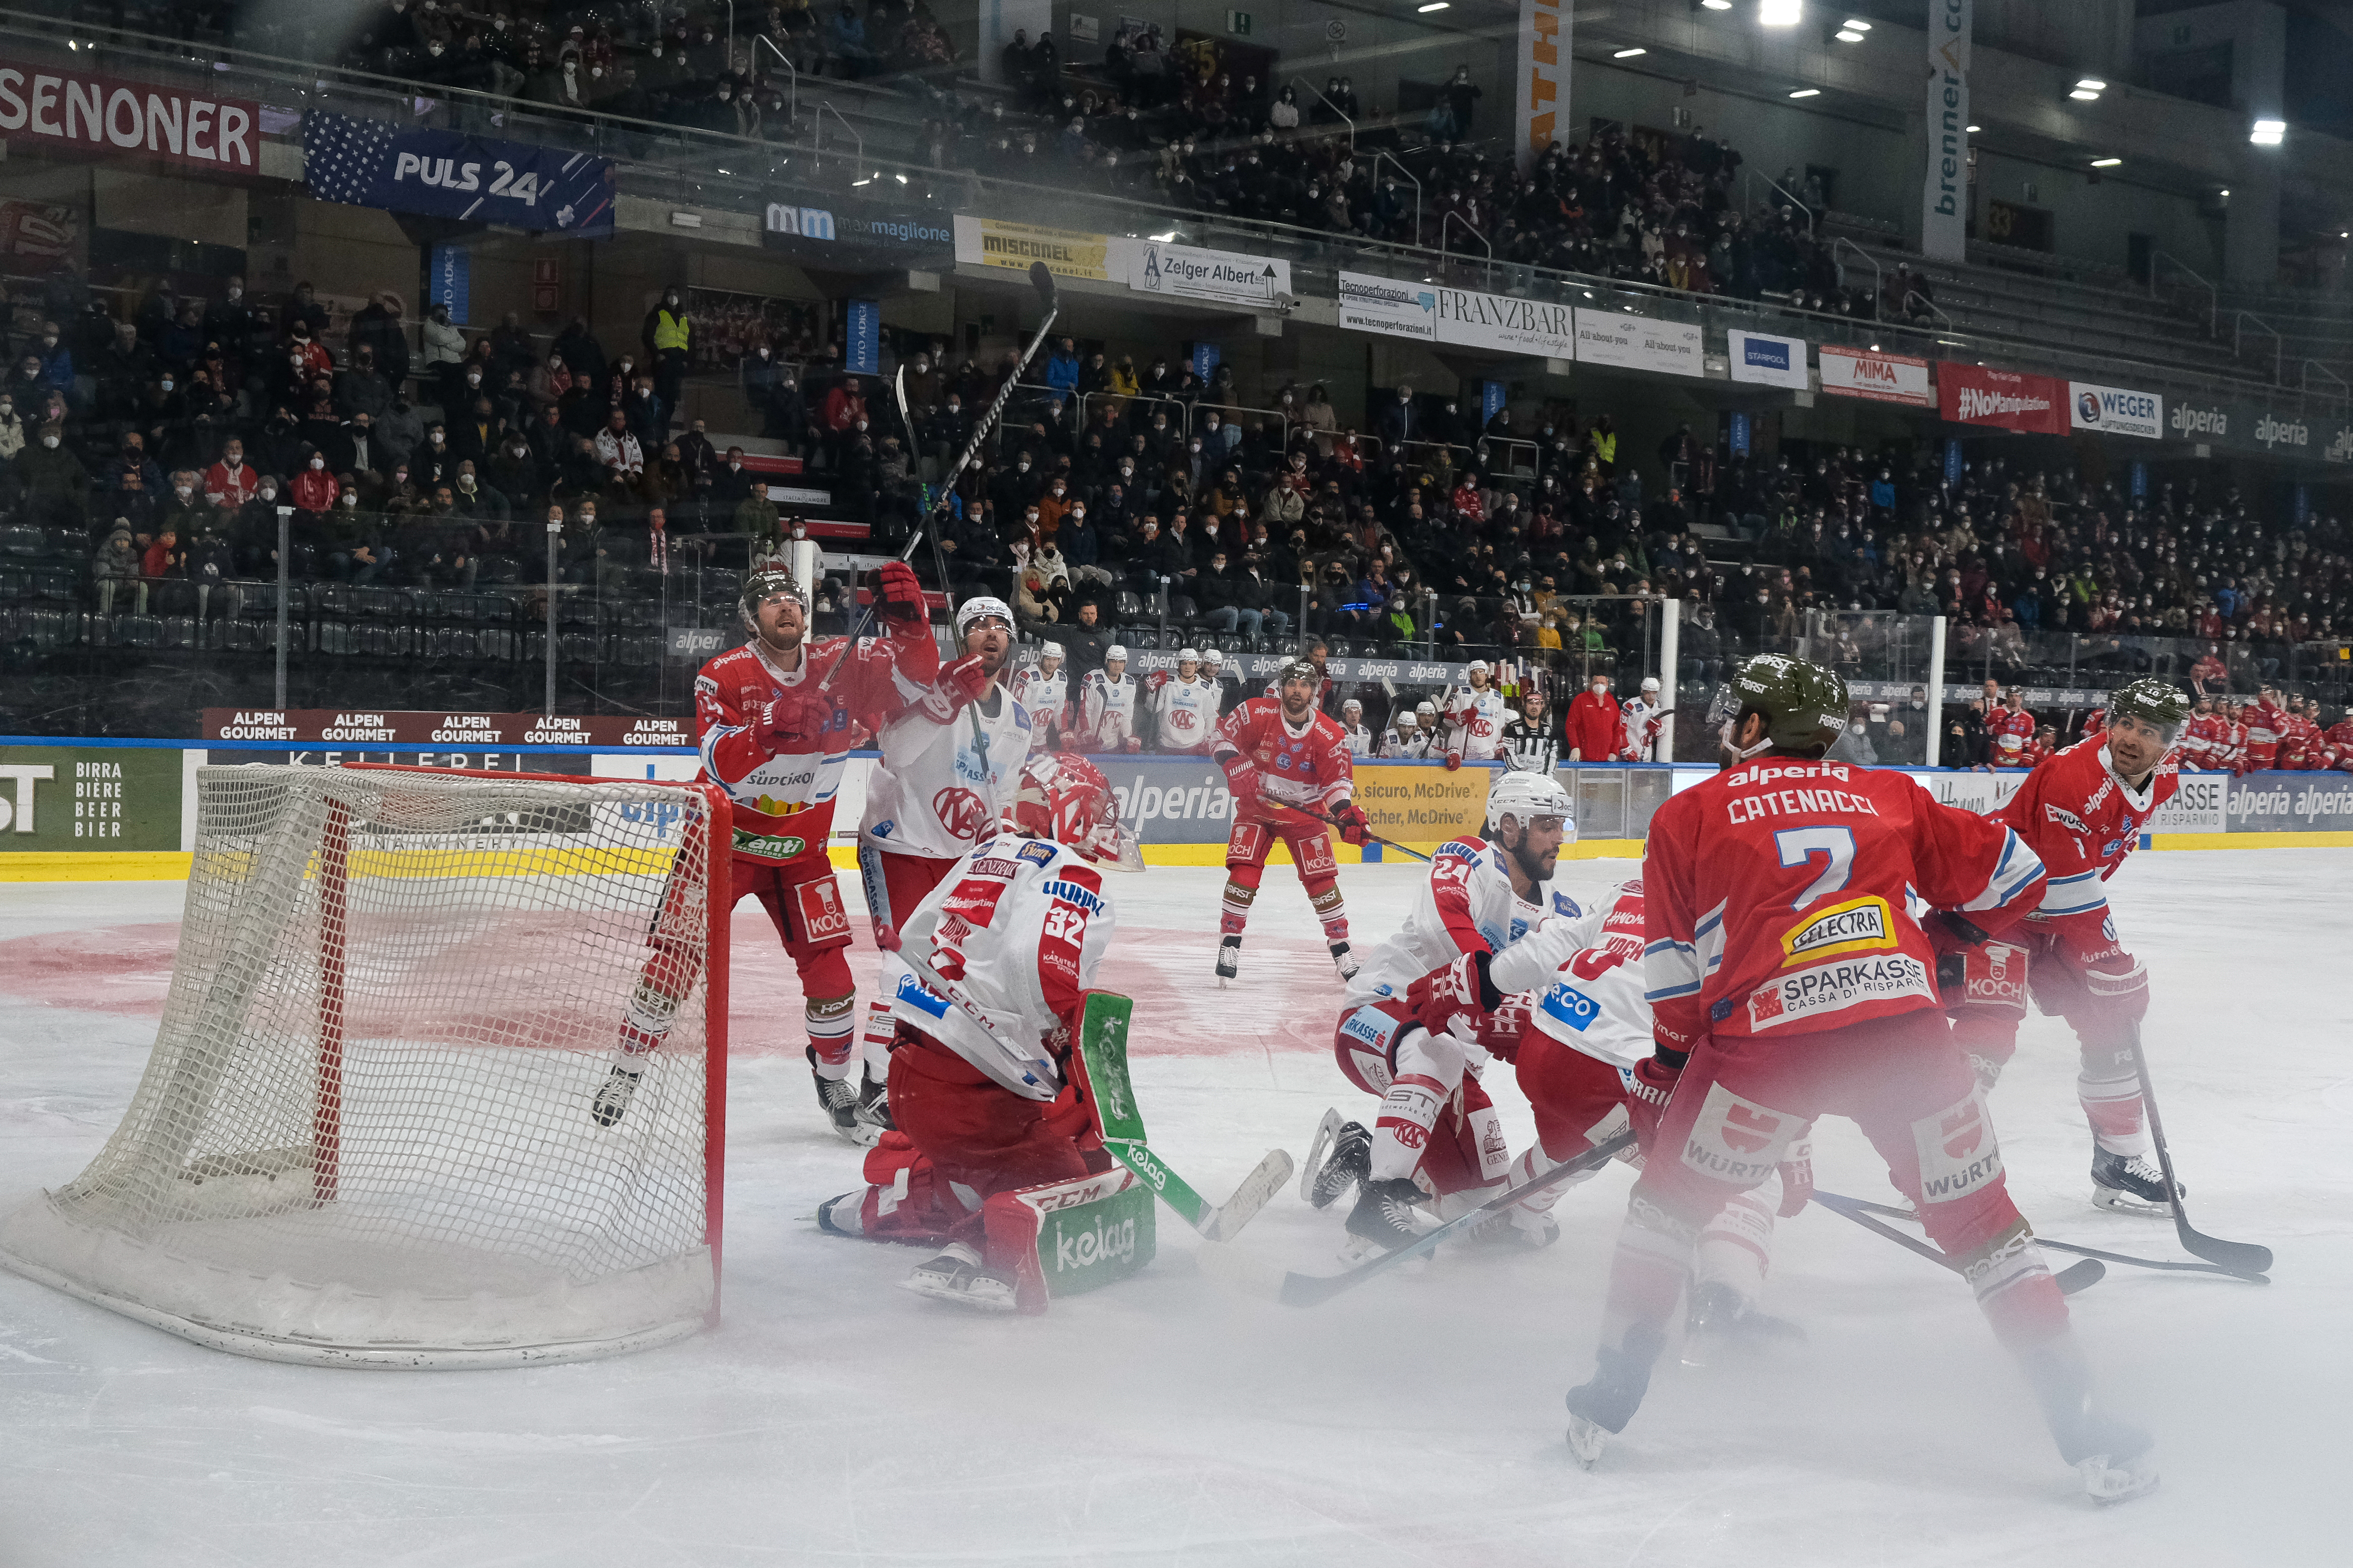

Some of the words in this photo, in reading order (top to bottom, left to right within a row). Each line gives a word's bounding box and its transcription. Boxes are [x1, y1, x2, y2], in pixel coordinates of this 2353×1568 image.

[0, 69, 251, 166] SENONER
[1934, 73, 1960, 216] brenner
[394, 152, 480, 191] PULS
[489, 161, 537, 206] 24
[1164, 257, 1209, 280] Zelger
[1212, 264, 1255, 284] Albert
[1341, 279, 1408, 301] Tecnoperforazioni
[1439, 289, 1569, 336] FRANZBAR
[1346, 316, 1431, 336] www.tecnoperforazioni.it
[1580, 330, 1591, 339] All
[1593, 333, 1613, 343] about
[1614, 336, 1628, 345] you
[1645, 339, 1655, 348] All
[1657, 341, 1676, 352] about
[1677, 345, 1691, 354] you
[857, 340, 867, 369] ALTO
[1747, 352, 1786, 364] STARPOOL
[1853, 359, 1898, 384] MIMA
[2101, 391, 2156, 420] WEGER
[2171, 402, 2227, 438] alperia
[2255, 413, 2309, 449] alperia
[712, 649, 753, 670] alperia
[1358, 661, 1398, 680] alperia
[1409, 663, 1447, 682] alperia
[1740, 677, 1769, 694] FORST
[2147, 688, 2160, 696] 10
[233, 712, 285, 725] ALPEN
[334, 714, 384, 727] ALPEN
[443, 716, 491, 728] ALPEN
[535, 717, 581, 730] ALPEN
[633, 720, 677, 733] ALPEN
[1169, 710, 1197, 729] KAC
[1470, 720, 1492, 737] KAC
[1818, 713, 1845, 730] FORST
[220, 727, 297, 740] GOURMET
[321, 728, 395, 741] GOURMET
[431, 730, 501, 743] GOURMET
[524, 731, 591, 744] GOURMET
[623, 733, 687, 746] GOURMET
[76, 762, 122, 778] BIRRA
[1727, 762, 1850, 787] alperia
[75, 778, 122, 798] BIÈRE
[1364, 781, 1412, 799] sicuro,
[75, 801, 121, 818] BEER
[1106, 775, 1229, 833] alperia
[1727, 789, 1879, 825] CATENACCI
[2227, 783, 2290, 824] alperia
[1368, 807, 1405, 826] icher,
[2161, 814, 2220, 826] RISPARMIO
[75, 822, 121, 838] BIER
[1306, 856, 1335, 869] KOCH
[1773, 825, 1857, 912] 7
[1516, 901, 1540, 914] CCM
[1044, 906, 1085, 950] 32
[1799, 912, 1879, 947] SELECTRA
[1784, 959, 1924, 1001] SPARKASSE
[1968, 978, 2022, 999] KOCH
[948, 986, 995, 1030] CCM
[1787, 992, 1836, 1012] CASSA
[1844, 987, 1858, 1000] DI
[1394, 1121, 1425, 1149] KAC
[1127, 1143, 1166, 1191] kelag
[1687, 1140, 1778, 1178] WÜRTH
[1923, 1145, 2001, 1197] WÜRTH
[1035, 1184, 1103, 1212] CCM
[1055, 1215, 1135, 1272] kelag
